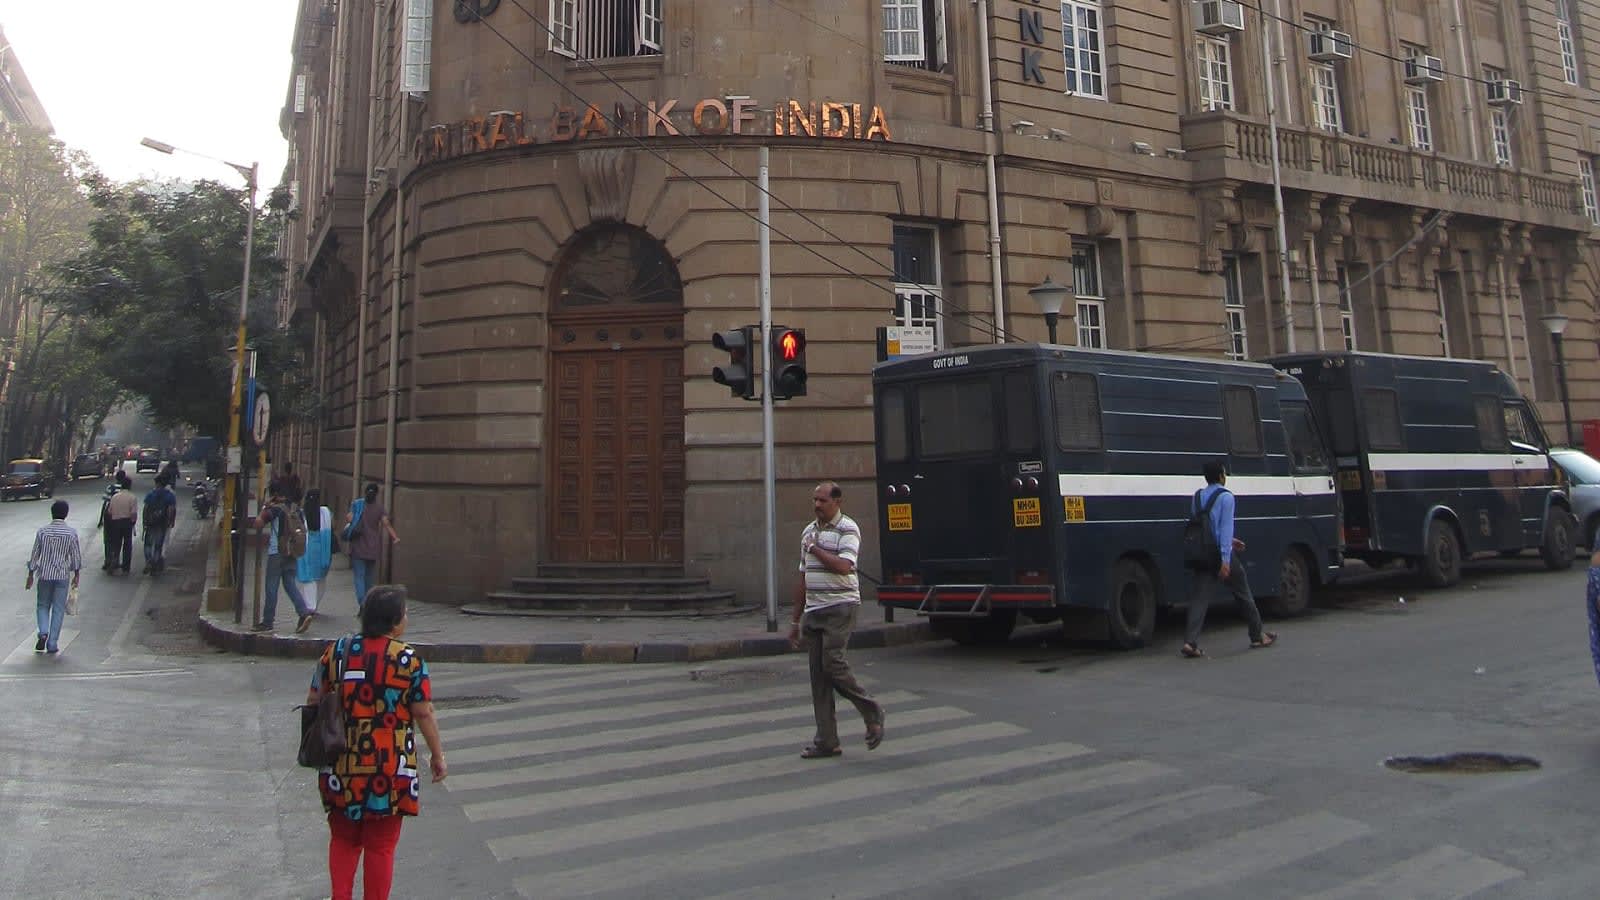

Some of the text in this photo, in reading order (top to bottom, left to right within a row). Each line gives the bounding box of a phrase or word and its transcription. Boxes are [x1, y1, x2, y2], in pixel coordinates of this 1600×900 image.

[1019, 0, 1046, 84] NK
[551, 99, 680, 141] BANK
[693, 98, 758, 136] OF
[774, 99, 892, 141] INDIA
[933, 355, 969, 369] GOVT OF INDIA
